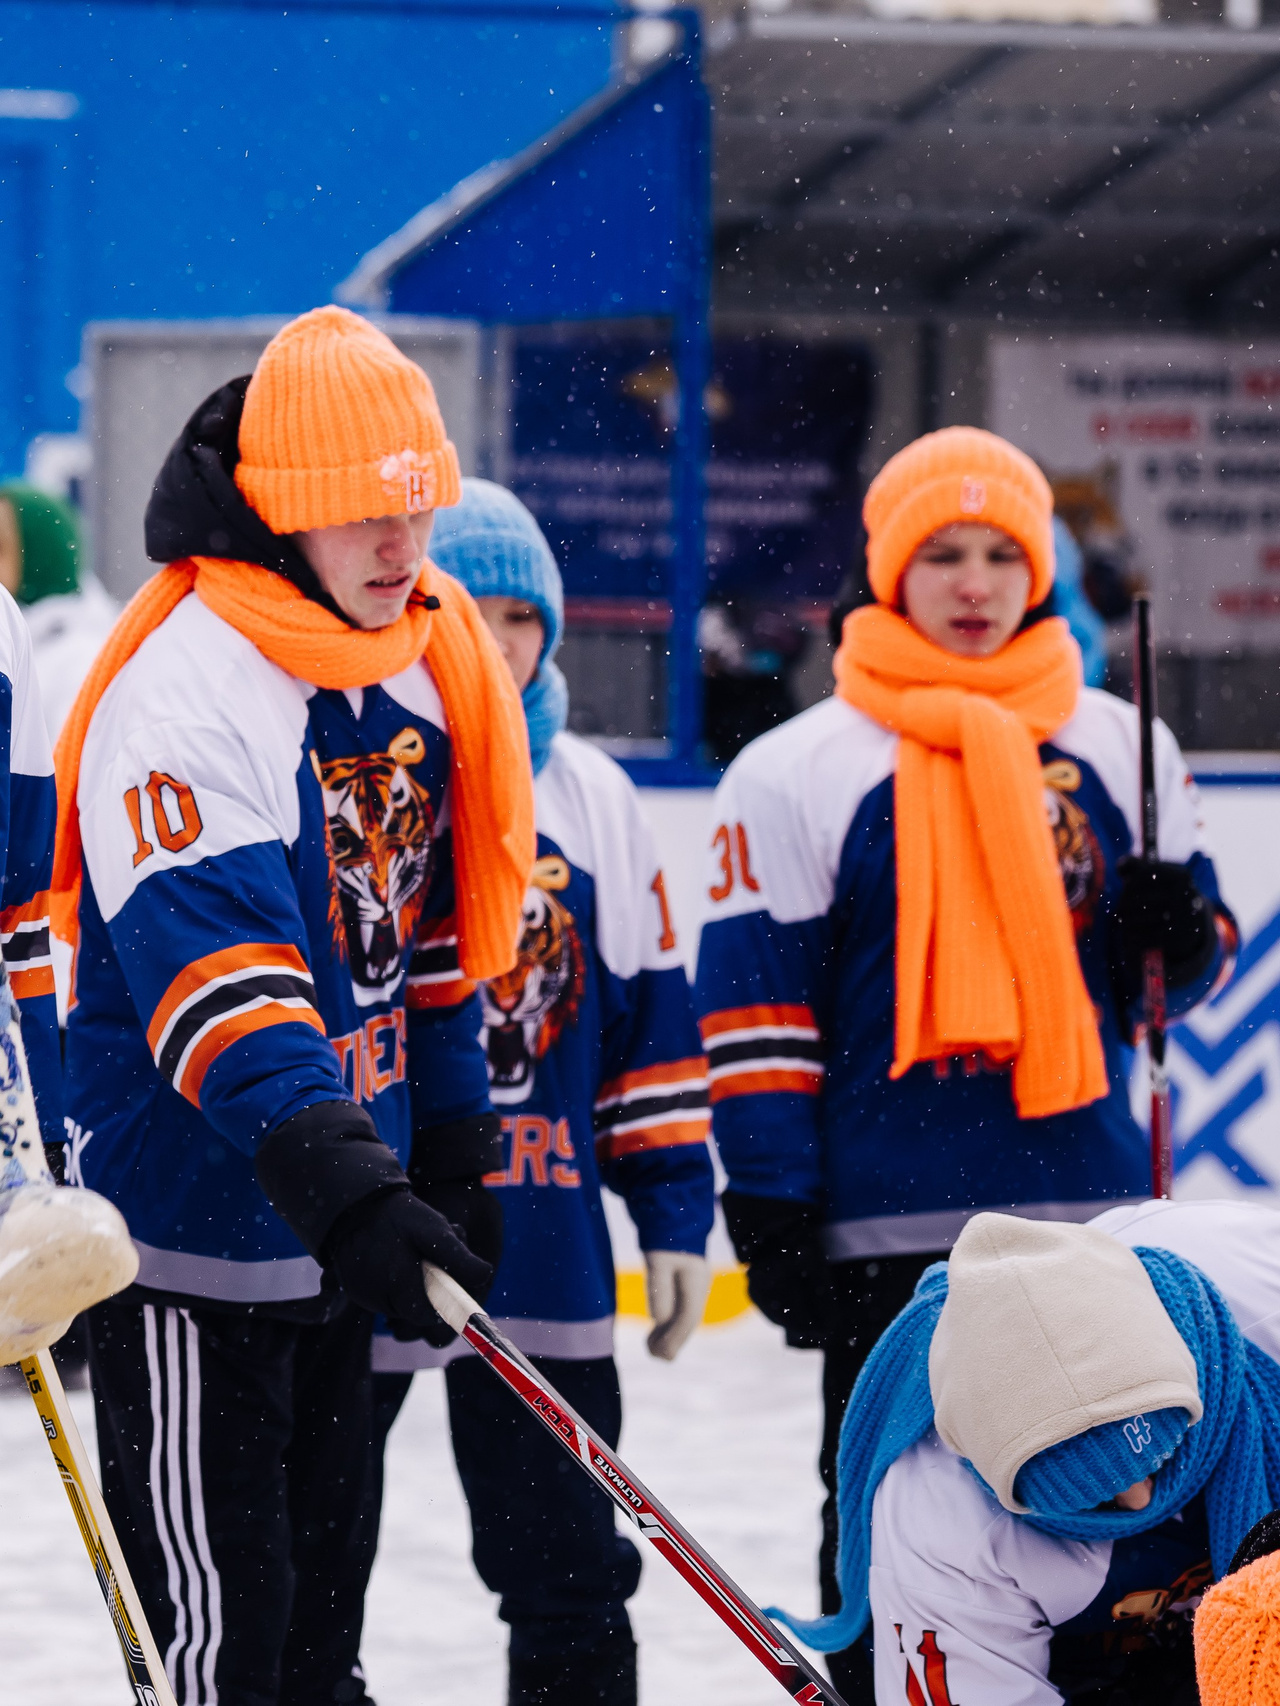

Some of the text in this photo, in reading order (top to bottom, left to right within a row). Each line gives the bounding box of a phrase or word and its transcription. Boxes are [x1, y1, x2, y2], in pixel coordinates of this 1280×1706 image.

[123, 770, 203, 868] 10
[25, 1367, 42, 1394] 1.5
[40, 1414, 57, 1441] JR
[532, 1395, 574, 1442] CCM
[593, 1454, 643, 1508] ULTIMATE
